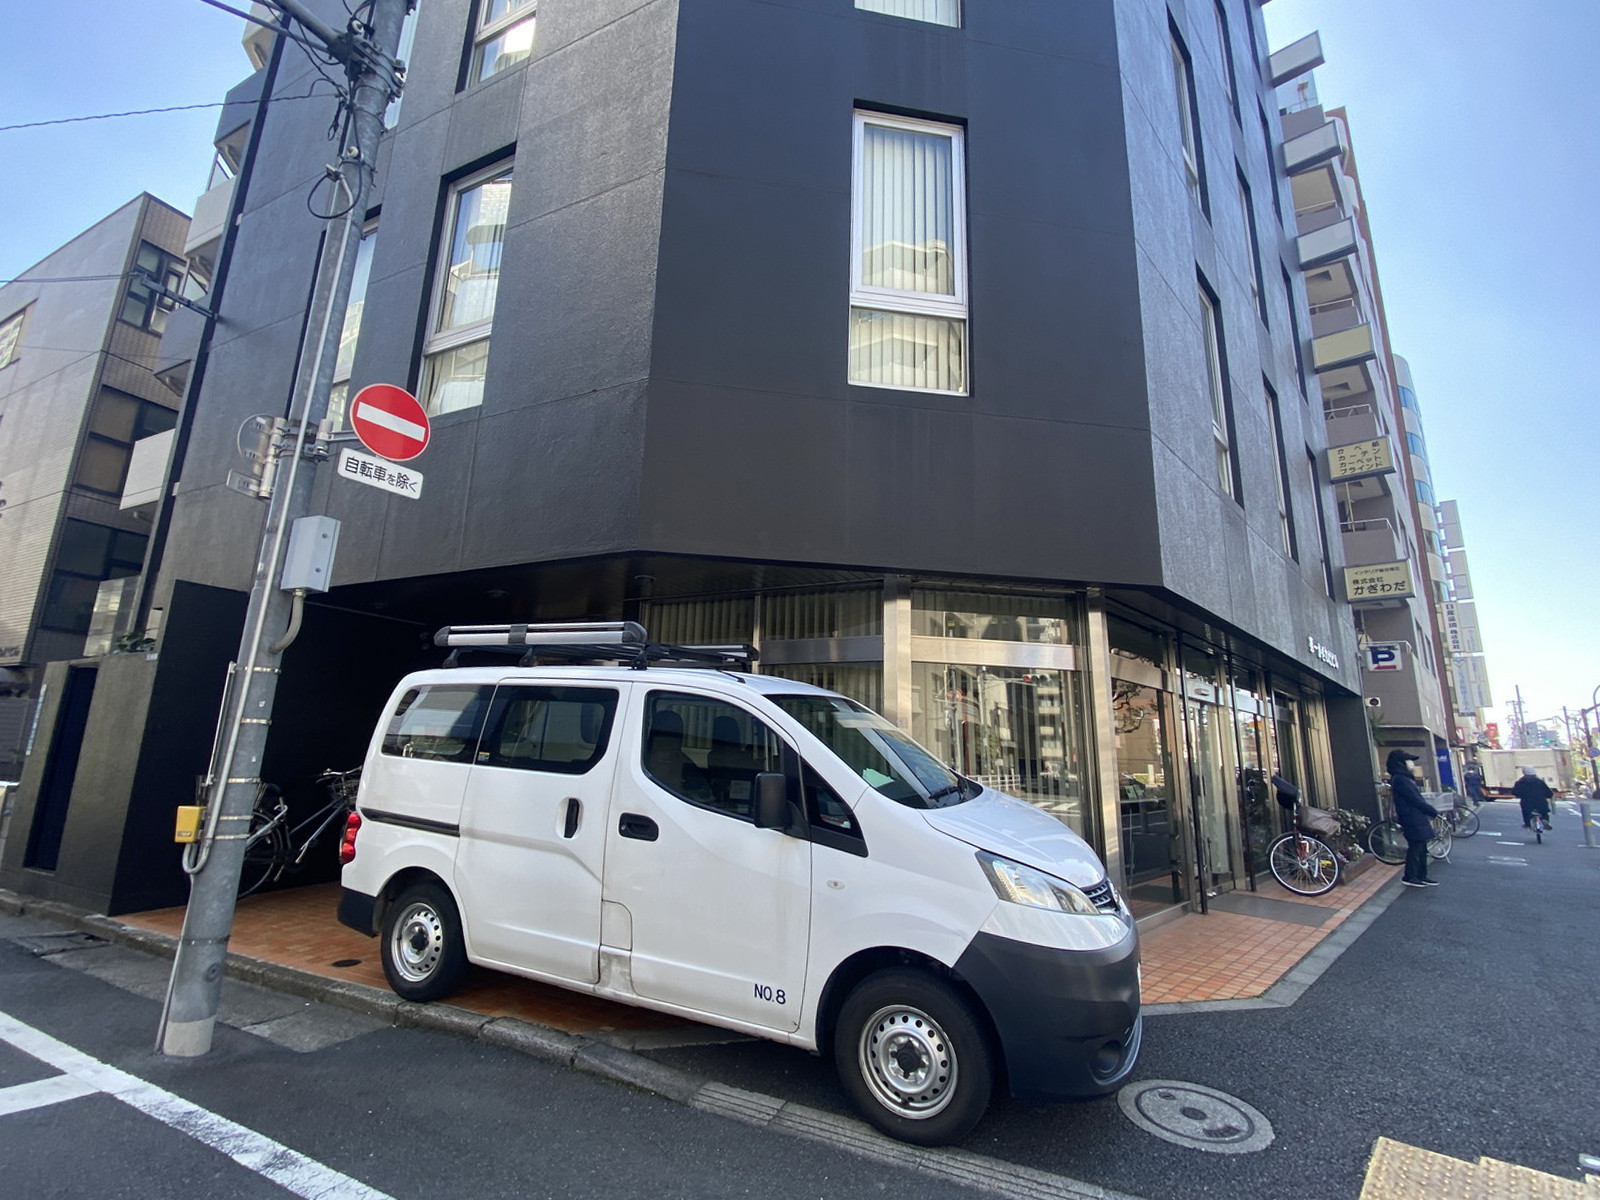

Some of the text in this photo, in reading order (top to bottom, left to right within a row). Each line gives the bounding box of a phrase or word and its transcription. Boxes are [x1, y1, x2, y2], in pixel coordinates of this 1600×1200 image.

[1338, 448, 1380, 462] カーテン
[1339, 456, 1381, 468] カーペット
[345, 457, 418, 492] 自転車を除く
[1340, 461, 1382, 475] ブラインド
[1352, 576, 1384, 585] 株式会社
[1353, 580, 1406, 596] かぎわだ
[1371, 648, 1396, 665] P
[754, 983, 786, 1005] NO.8
